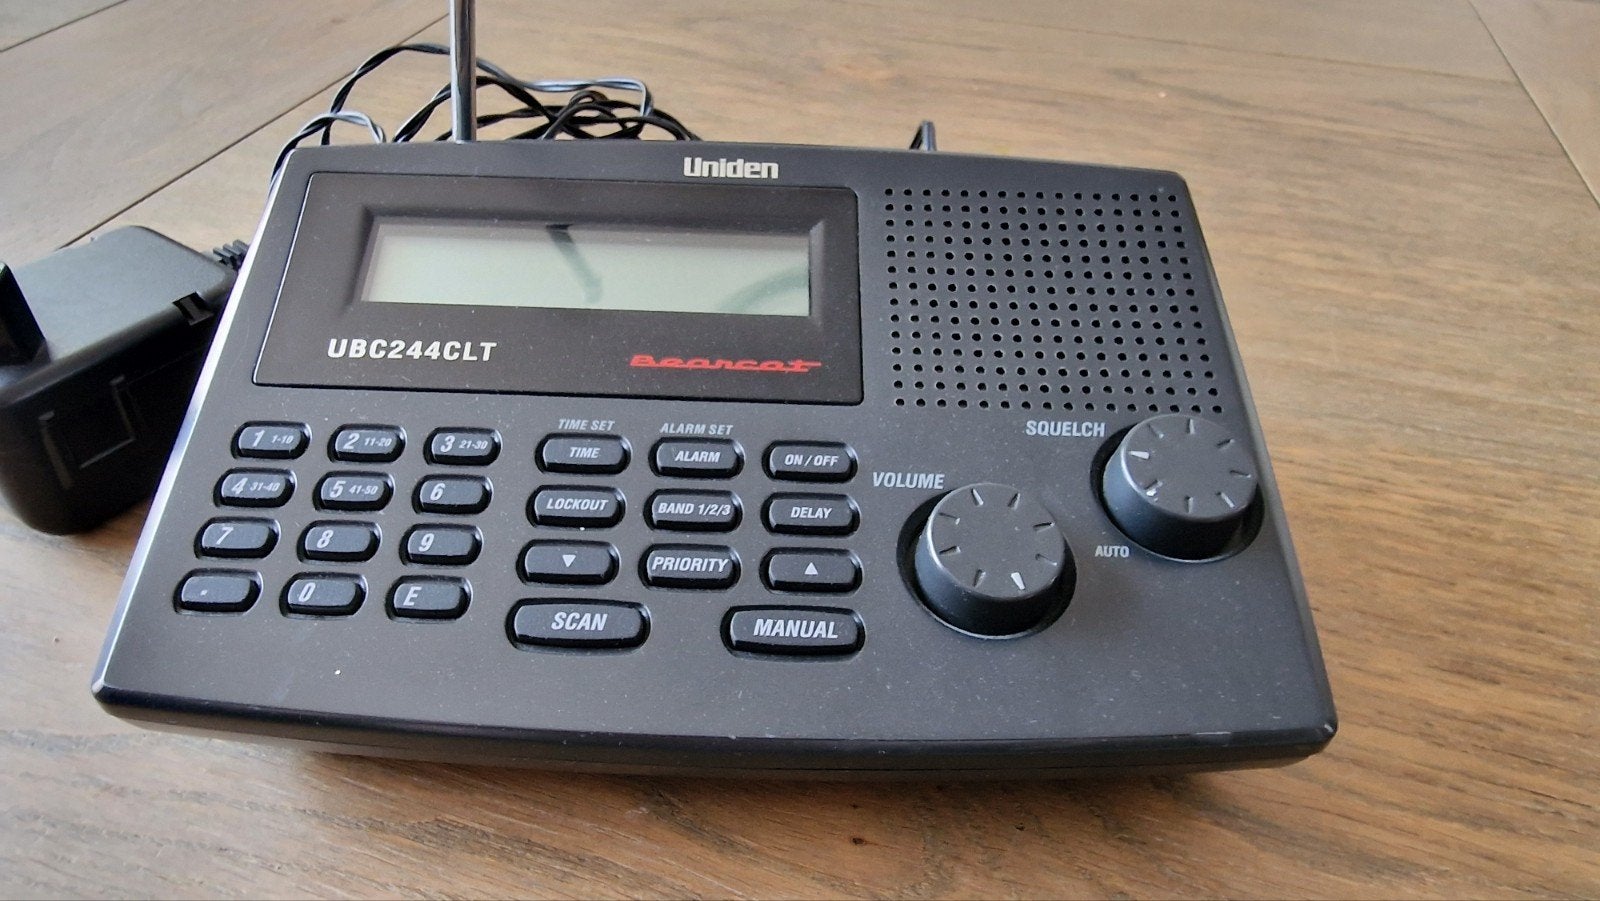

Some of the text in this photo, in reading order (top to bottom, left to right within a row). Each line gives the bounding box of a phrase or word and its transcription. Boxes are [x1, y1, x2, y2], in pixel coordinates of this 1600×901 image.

[683, 156, 779, 179] Uniden
[327, 338, 497, 362] UBC244CLT
[629, 354, 822, 374] Bearcat
[558, 419, 615, 431] TIME SET
[660, 423, 733, 435] ALARM SET
[1025, 420, 1106, 438] SQUELCH
[252, 430, 293, 447] 1 1-10
[344, 433, 393, 450] 2 11-20
[440, 435, 488, 452] 3 21-30
[569, 446, 601, 459] TIME
[674, 450, 721, 463] ALARM
[784, 454, 802, 466] ON
[814, 455, 838, 467] OFF
[231, 478, 281, 495] 4 31-40
[330, 480, 379, 498] 5 41-50
[872, 472, 945, 490] VOLUME
[430, 483, 445, 501] 6
[546, 497, 608, 511] LOCKOUT
[658, 503, 731, 517] BAND 1/2/3
[790, 506, 833, 519] DELAY
[215, 527, 234, 545] 7
[316, 530, 334, 548] 8
[418, 533, 434, 552] 9
[1095, 545, 1130, 558] AUTO
[652, 556, 729, 573] PRIORITY
[298, 582, 316, 602] 0
[403, 586, 422, 606] E
[551, 612, 608, 632] SCAN
[753, 618, 839, 639] MANUAL
